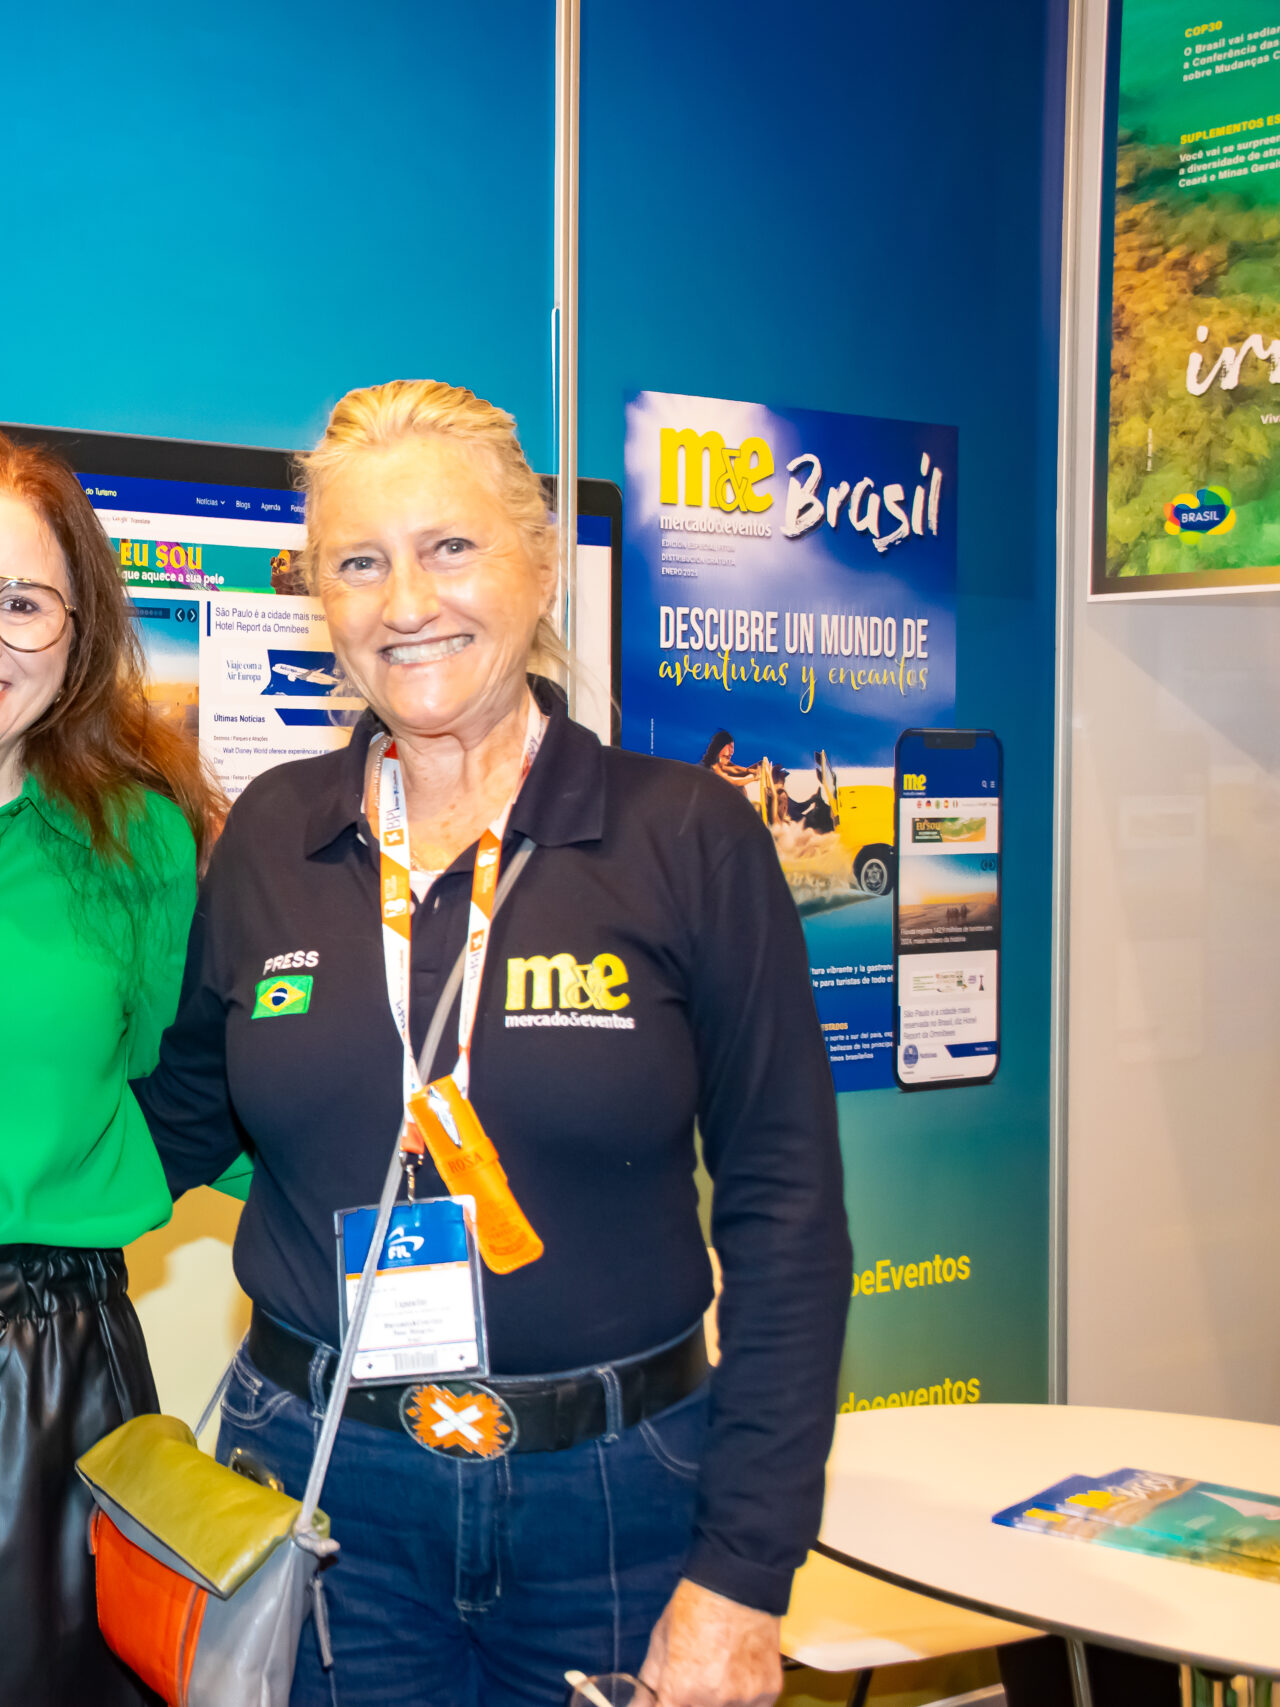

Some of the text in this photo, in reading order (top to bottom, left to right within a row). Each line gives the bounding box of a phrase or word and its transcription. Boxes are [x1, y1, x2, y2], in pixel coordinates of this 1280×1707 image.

[1185, 20, 1223, 38] COP30
[1184, 47, 1192, 56] O
[1195, 38, 1226, 54] Brasil
[1228, 33, 1244, 45] vai
[1192, 44, 1257, 67] Conferência
[1260, 39, 1279, 50] das
[1183, 69, 1212, 82] sobre
[1215, 55, 1270, 74] Mudanças
[1181, 117, 1264, 145] SUPLEMENTOS
[1180, 150, 1204, 162] Você
[1206, 146, 1220, 157] vai
[1222, 145, 1235, 154] se
[1187, 154, 1245, 174] diversidade
[1247, 151, 1260, 161] de
[1179, 173, 1208, 188] Ceará
[1210, 174, 1216, 182] e
[1218, 167, 1249, 180] Minas
[235, 500, 251, 510] Blogs
[261, 502, 281, 512] Agenda
[780, 452, 942, 552] Brasil
[660, 514, 772, 537] mercado&eventos
[120, 542, 202, 570] EU SOU
[121, 571, 140, 584] que
[141, 571, 177, 584] aquece
[185, 574, 201, 584] sua
[203, 575, 225, 586] pele
[215, 607, 230, 617] São
[232, 608, 253, 618] Paulo
[254, 609, 260, 618] é
[268, 610, 291, 620] cidade
[293, 612, 310, 621] mais
[215, 621, 309, 634] Hotel Report da Omnibees
[659, 605, 928, 659] DESCUBRE UN MUNDO DE
[243, 662, 257, 670] com
[227, 672, 261, 682] Air Europa
[659, 649, 928, 713] aventuras y encantos
[214, 712, 238, 722] Últimas
[236, 747, 252, 755] Disney
[262, 950, 320, 976] PRESS
[505, 953, 631, 1012] m&e
[505, 1013, 635, 1030] mercado&eventos
[447, 1152, 483, 1174] ROSA
[388, 1245, 411, 1259] FIL
